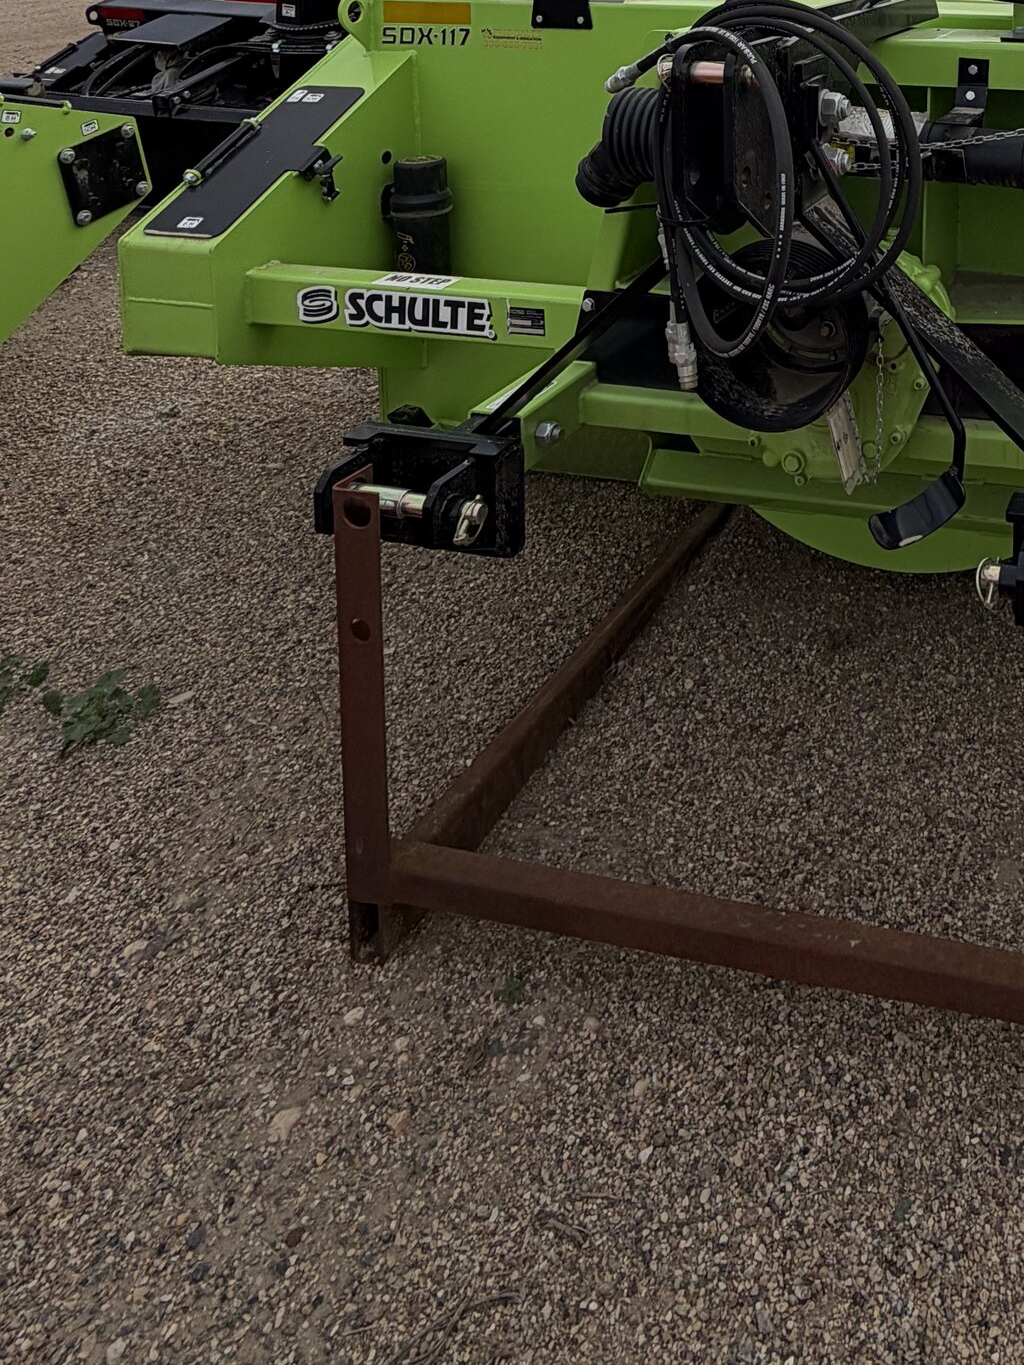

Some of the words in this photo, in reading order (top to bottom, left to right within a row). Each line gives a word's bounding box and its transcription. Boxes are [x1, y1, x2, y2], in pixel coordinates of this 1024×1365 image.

[385, 274, 412, 283] NO
[409, 276, 452, 286] STEP
[347, 291, 488, 333] SCHULTE
